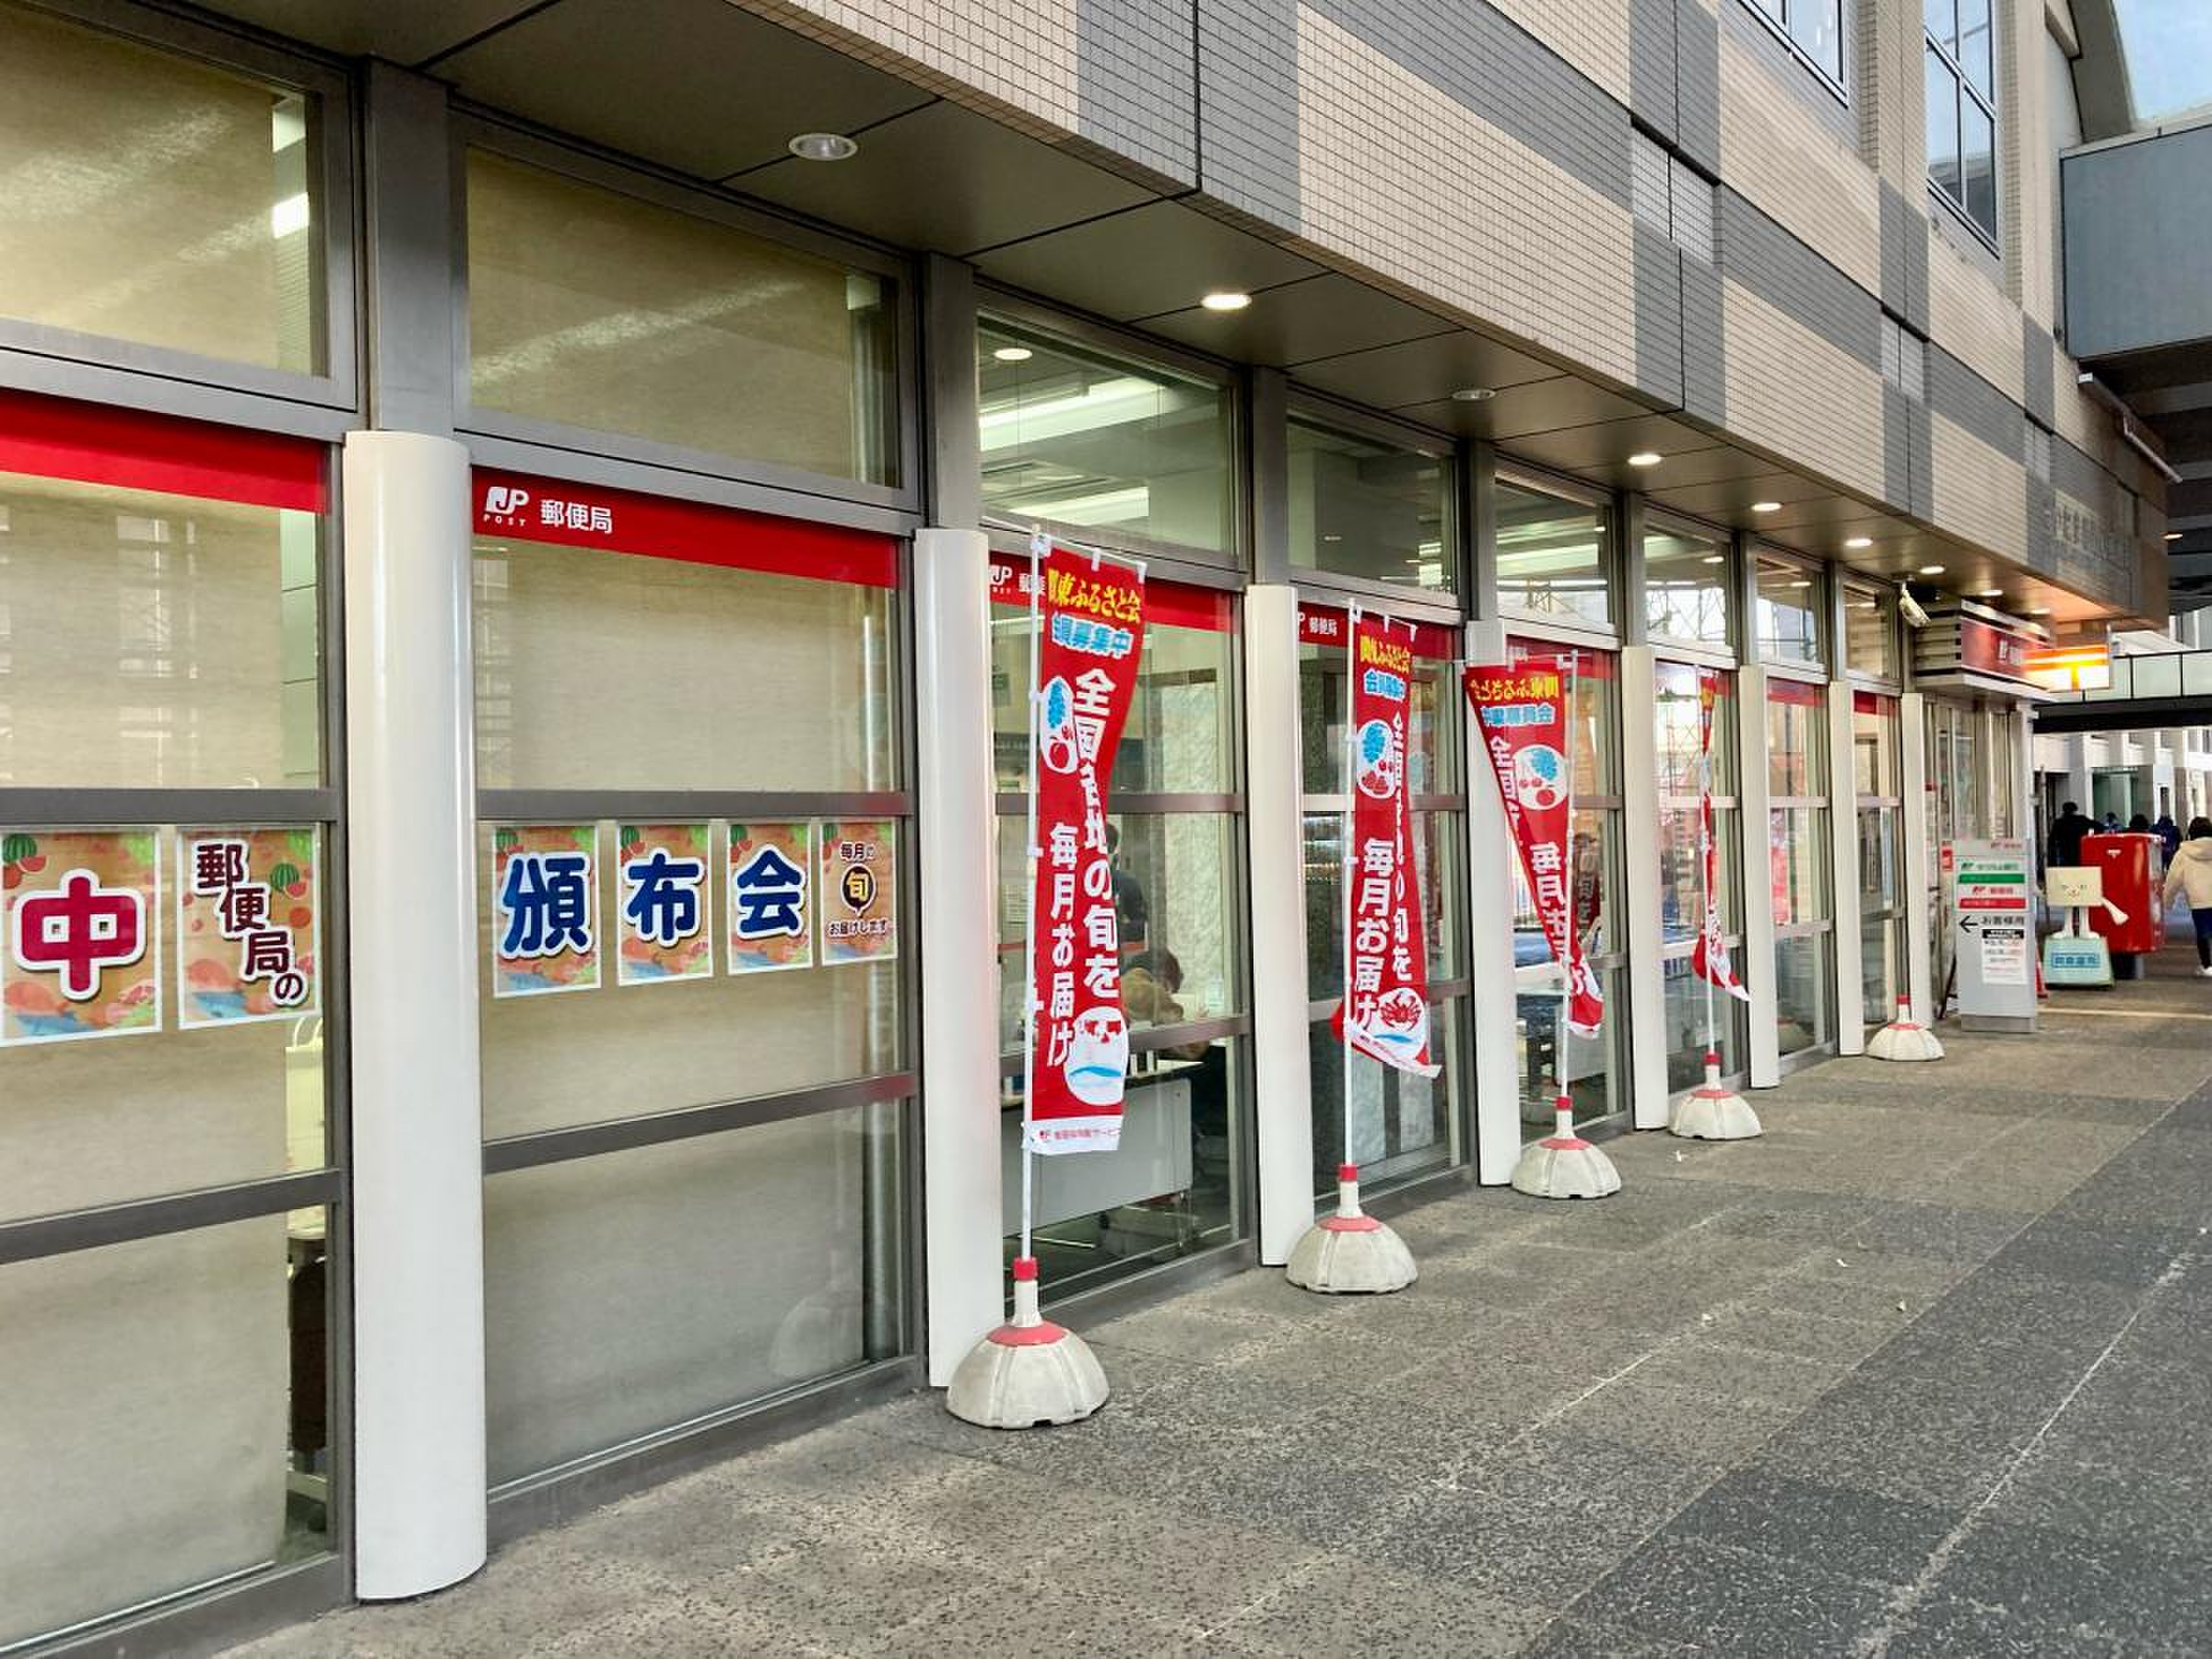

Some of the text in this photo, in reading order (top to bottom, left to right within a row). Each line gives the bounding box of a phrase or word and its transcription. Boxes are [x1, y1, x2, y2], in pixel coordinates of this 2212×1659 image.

[483, 513, 526, 526] POST
[540, 499, 613, 535] 郵便局
[20, 876, 137, 993] 中
[196, 843, 303, 1001] 郵便局の
[847, 872, 868, 901] 旬
[1046, 822, 1078, 1066] 毎月お届け
[1356, 837, 1394, 1030] 毎月お届け
